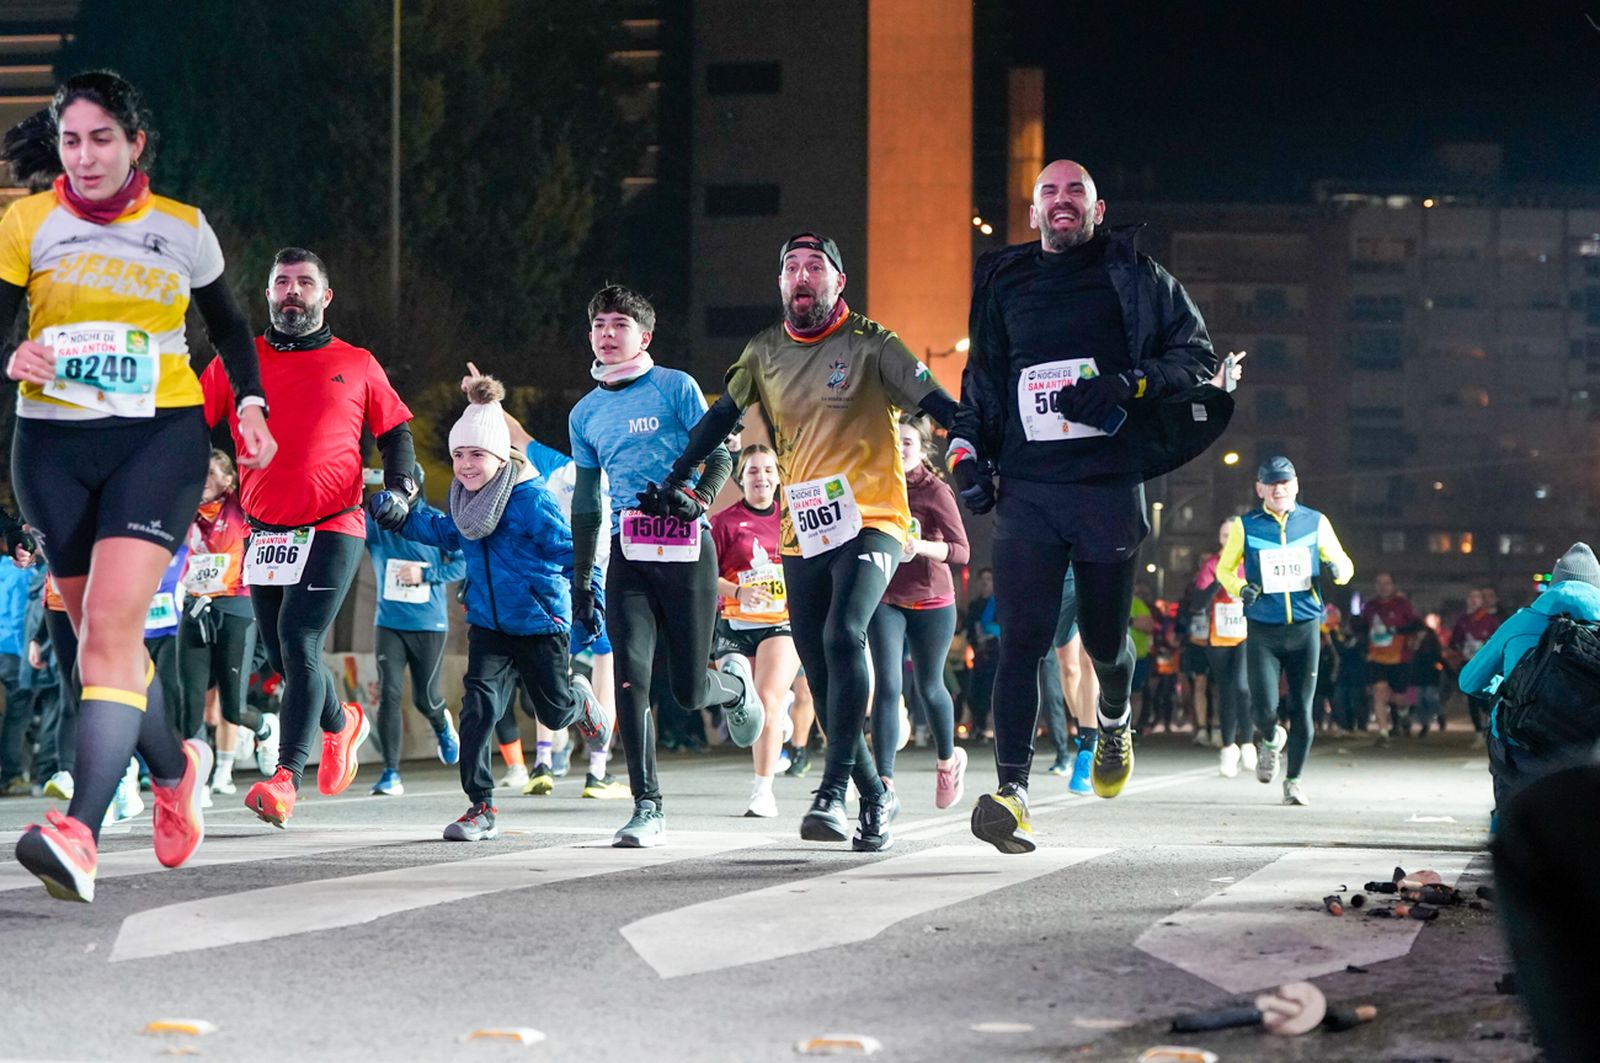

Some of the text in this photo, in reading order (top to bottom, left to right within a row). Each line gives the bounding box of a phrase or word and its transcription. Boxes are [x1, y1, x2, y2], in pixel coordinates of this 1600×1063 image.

[71, 333, 115, 343] NOCHE DE
[59, 347, 79, 356] SAN
[65, 355, 137, 383] 8240
[1037, 369, 1072, 380] NOCHE DE
[1028, 381, 1045, 391] SAN
[1034, 390, 1062, 415] 50
[628, 416, 660, 433] M10
[798, 501, 842, 533] 5067
[630, 517, 691, 538] 15025
[256, 545, 299, 565] 5066
[751, 580, 784, 596] 13
